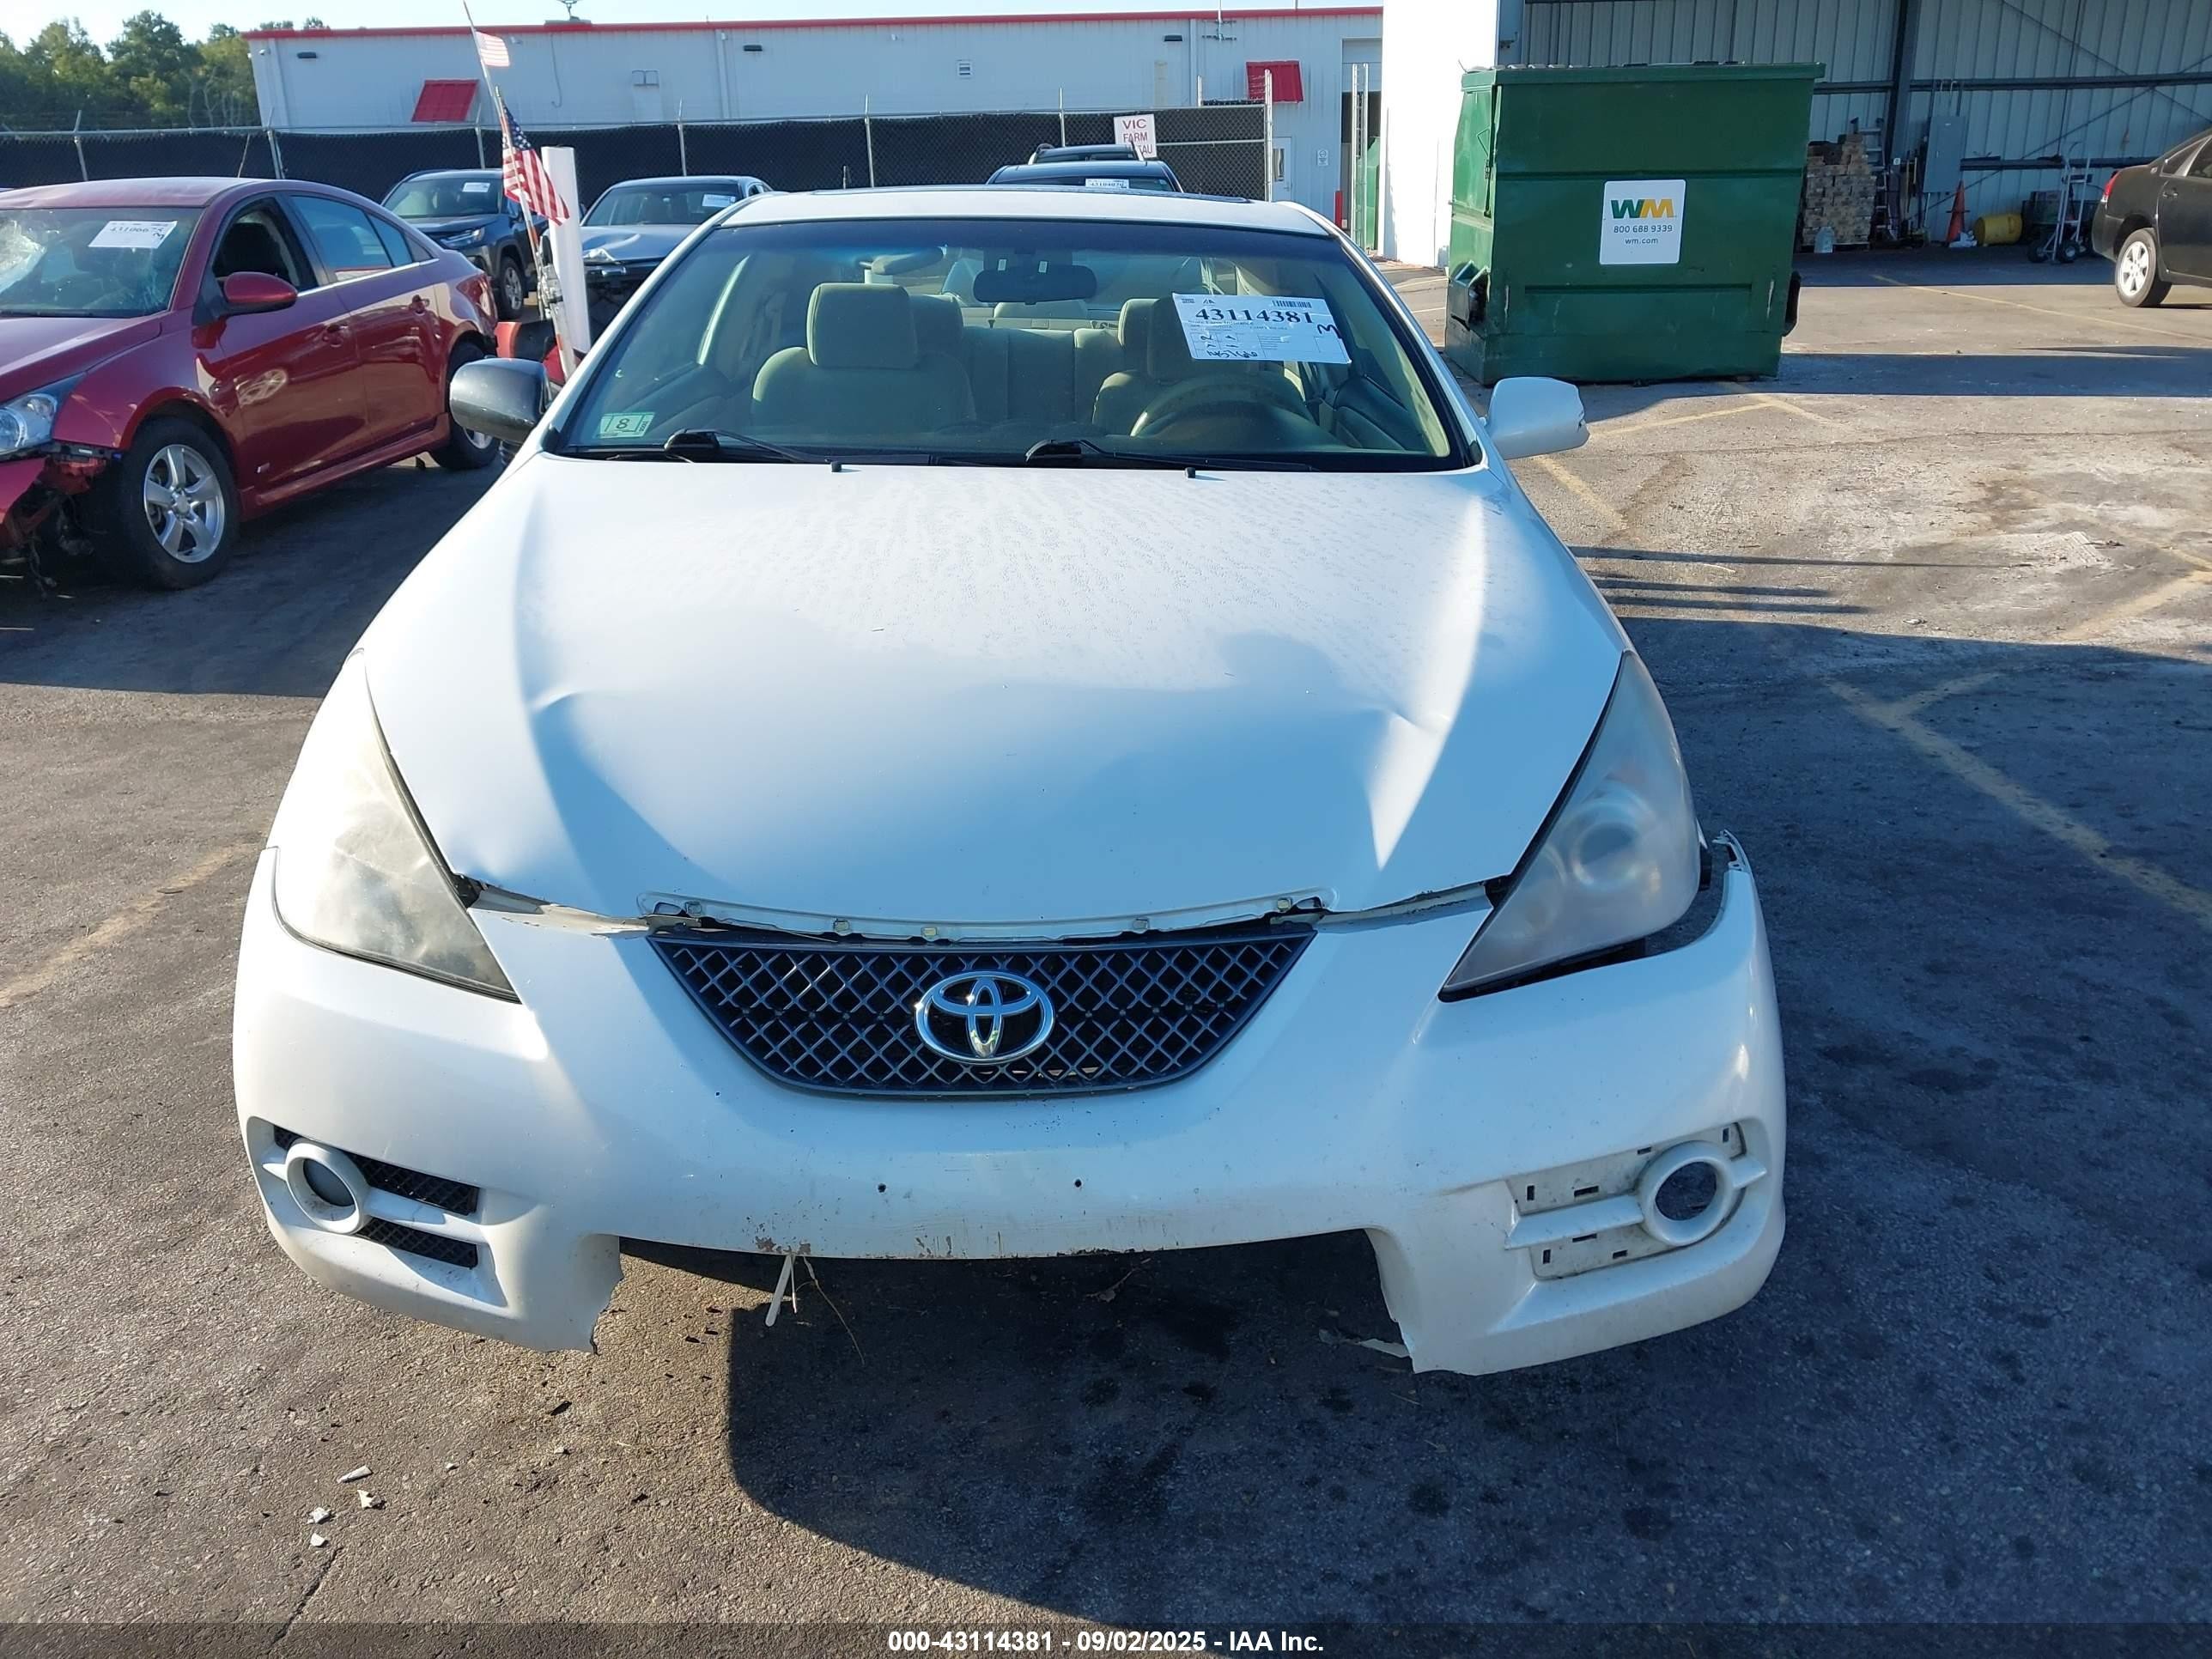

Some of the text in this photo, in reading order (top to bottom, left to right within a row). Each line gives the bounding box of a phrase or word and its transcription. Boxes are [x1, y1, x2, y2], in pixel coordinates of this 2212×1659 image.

[1122, 118, 1147, 130] VIC
[1123, 132, 1148, 143] FARM
[1611, 198, 1674, 219] WM
[1613, 225, 1631, 234] 800
[1650, 224, 1673, 233] 9339
[1195, 307, 1314, 324] 43114381
[616, 418, 630, 429] 8
